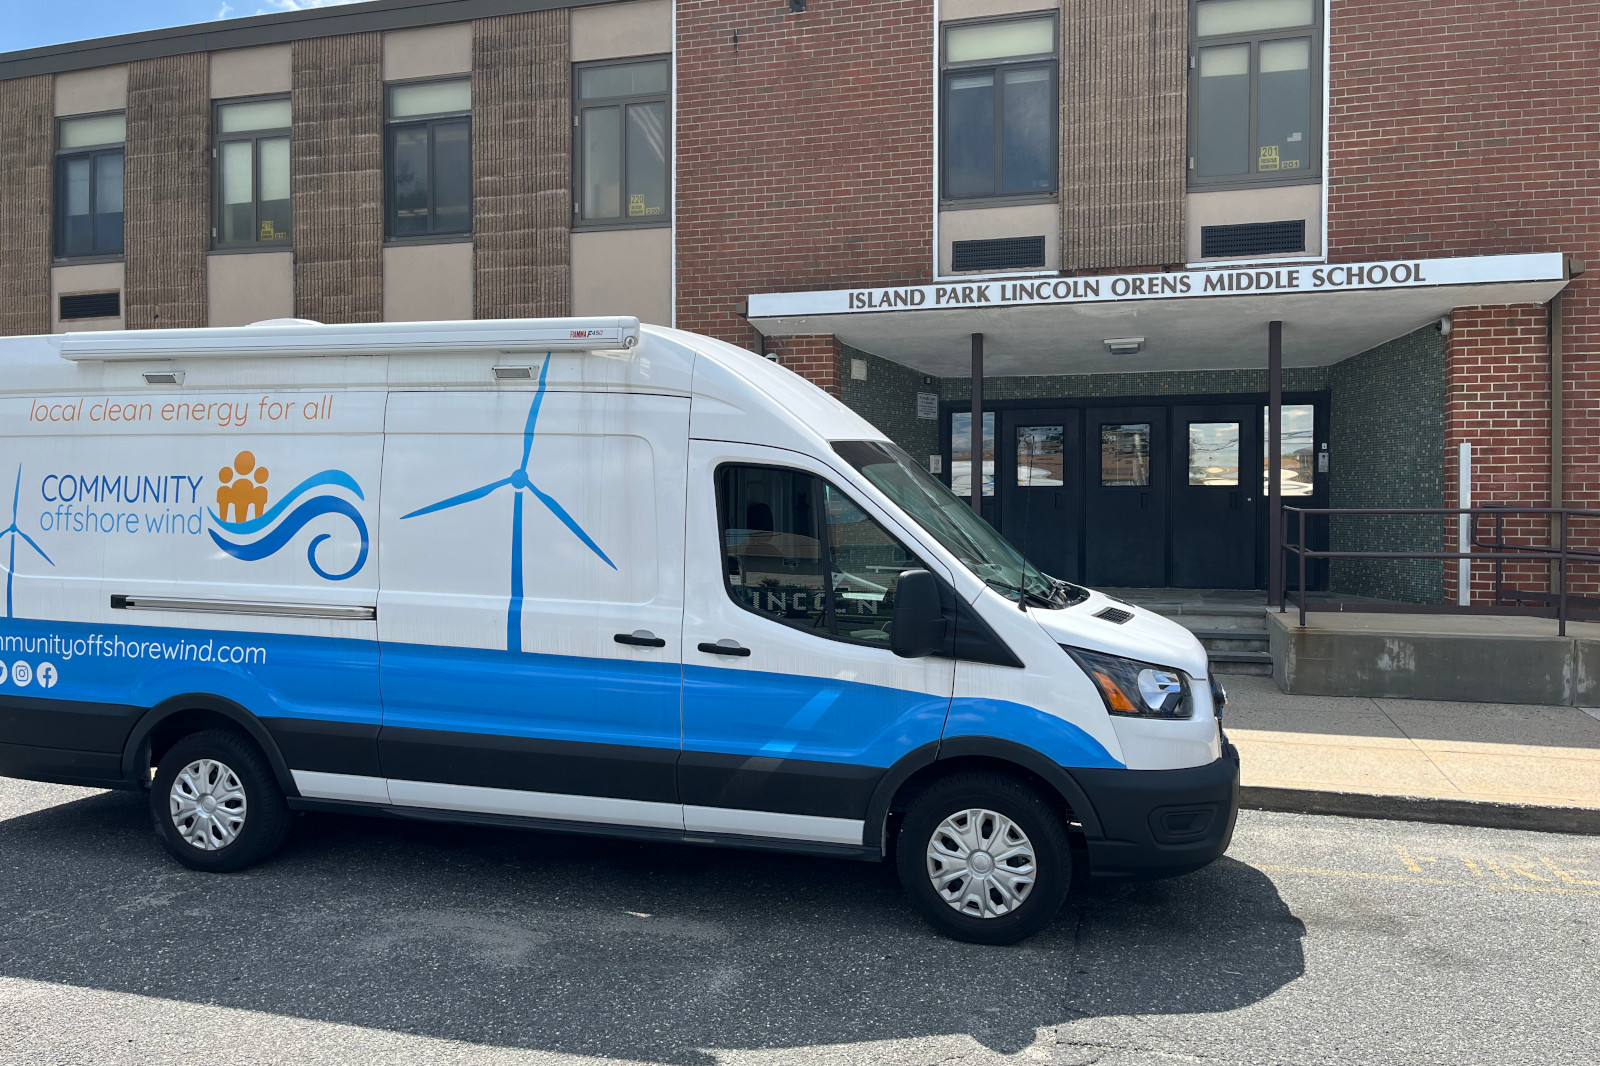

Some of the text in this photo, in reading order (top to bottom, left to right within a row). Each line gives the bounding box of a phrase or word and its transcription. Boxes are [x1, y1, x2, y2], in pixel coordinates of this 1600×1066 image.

[1262, 147, 1278, 157] 201
[1282, 161, 1298, 169] 201
[631, 195, 644, 203] 220
[848, 263, 1426, 309] ISLAND PARK LINCOLN ORENS MIDDLE SCHOOL
[29, 394, 334, 427] local clean energy for all
[41, 474, 204, 504] COMMUNITY
[40, 504, 203, 535] offshore wind
[0, 633, 267, 664] munityoffshorewind.com
